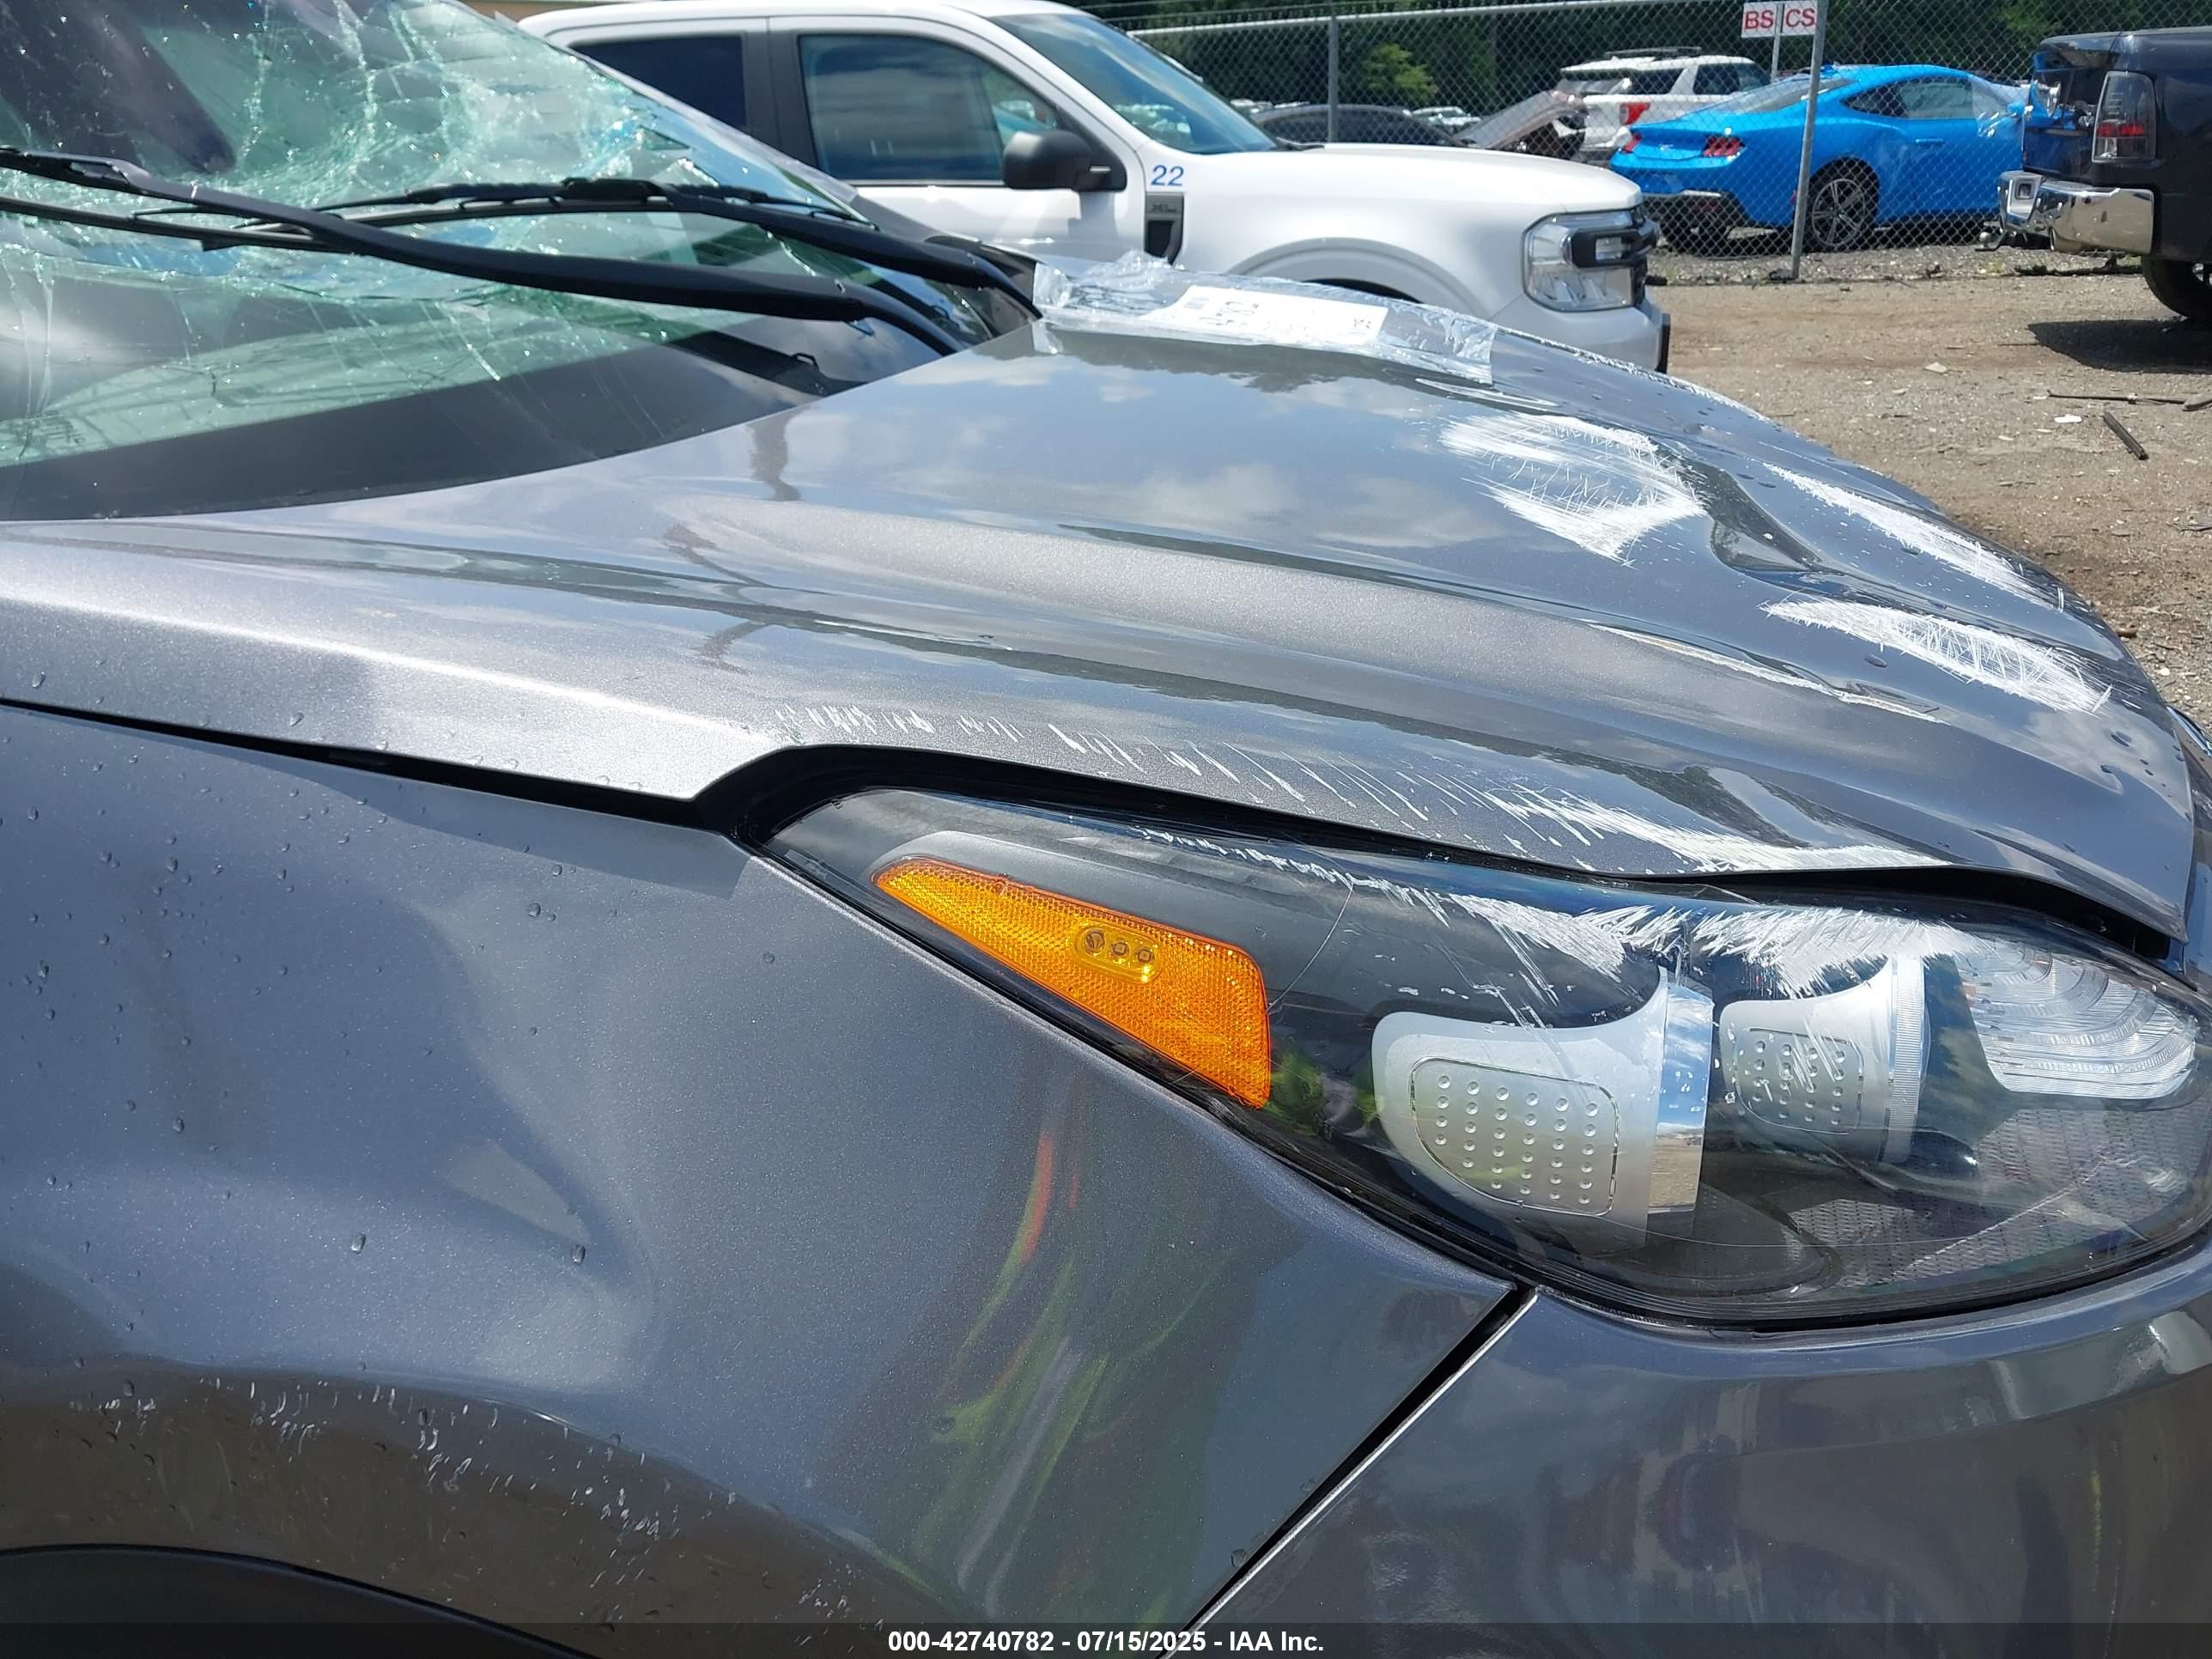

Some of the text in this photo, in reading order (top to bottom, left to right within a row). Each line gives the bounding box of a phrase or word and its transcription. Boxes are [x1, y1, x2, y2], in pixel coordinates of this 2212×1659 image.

[1744, 9, 1774, 29] BS
[1785, 8, 1815, 27] CS
[1151, 164, 1184, 186] 22
